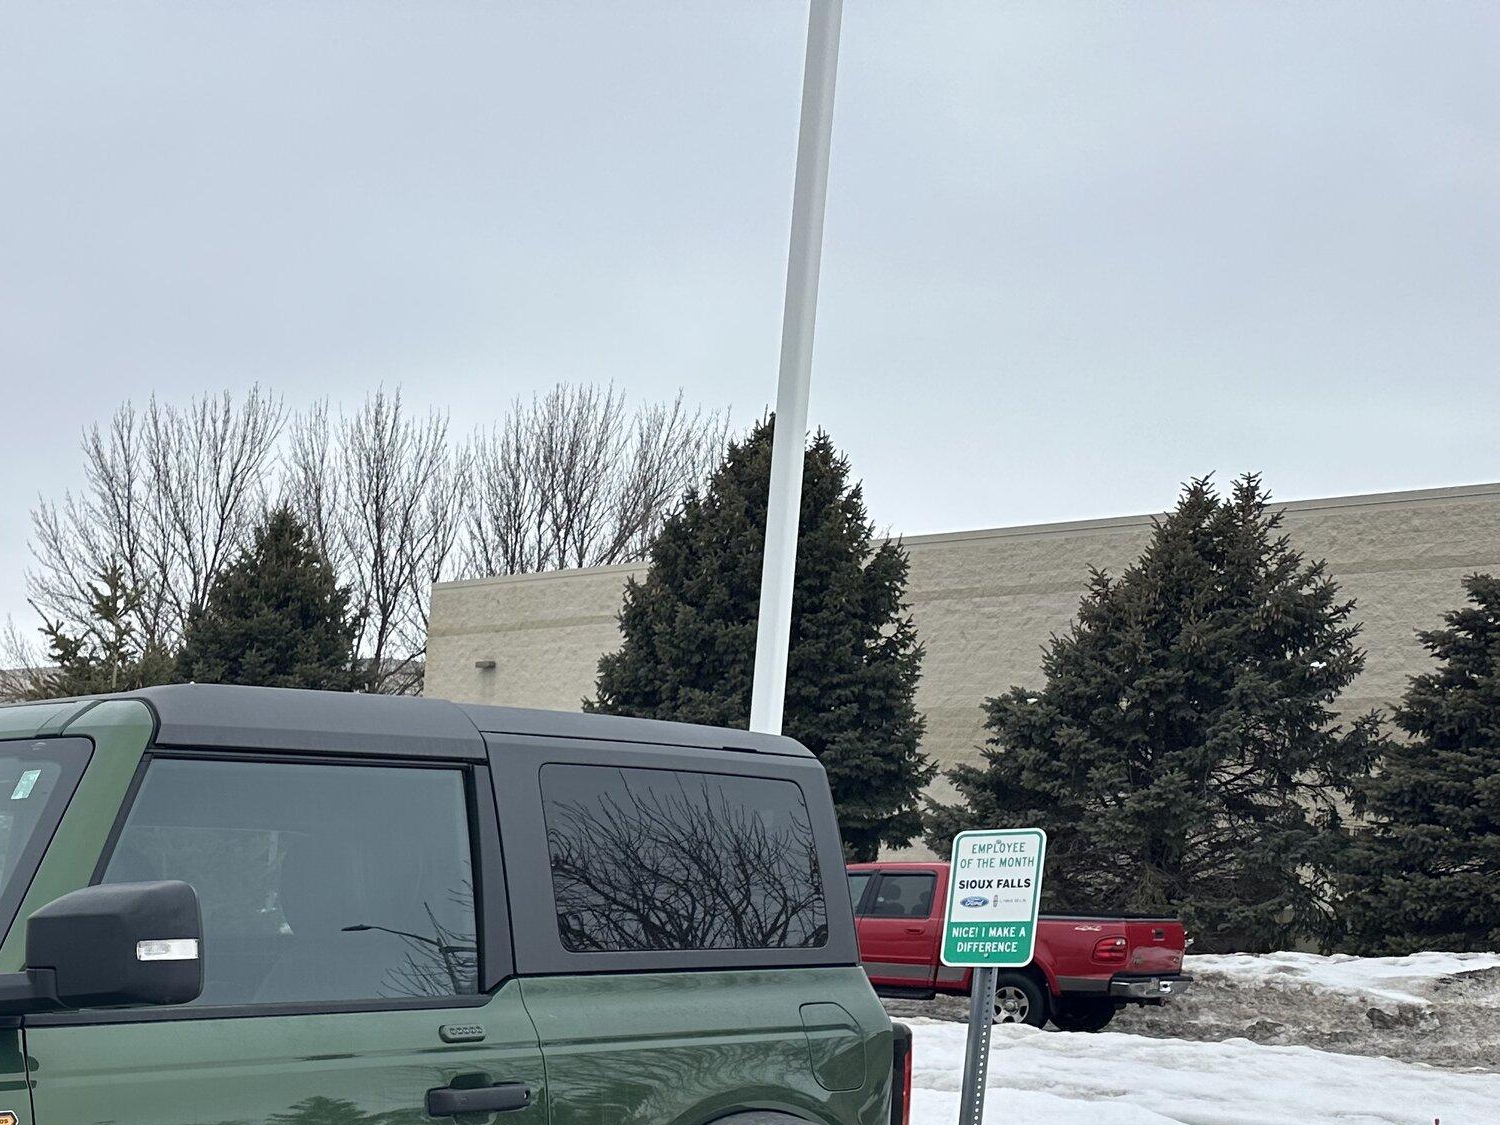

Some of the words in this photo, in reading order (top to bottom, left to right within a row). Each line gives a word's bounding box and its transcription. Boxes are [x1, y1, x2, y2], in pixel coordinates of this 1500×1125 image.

[972, 842, 1026, 854] EMPLOYEE
[960, 859, 973, 869] OF
[977, 858, 995, 868] THE
[1000, 857, 1034, 868] MONTH
[959, 880, 993, 889] SIOUX
[997, 879, 1031, 888] FALLS
[952, 927, 978, 938] NICE!
[982, 927, 986, 937] I
[989, 927, 1016, 937] MAKE
[1019, 927, 1026, 937] A
[957, 942, 1018, 953] DIFFERENCE
